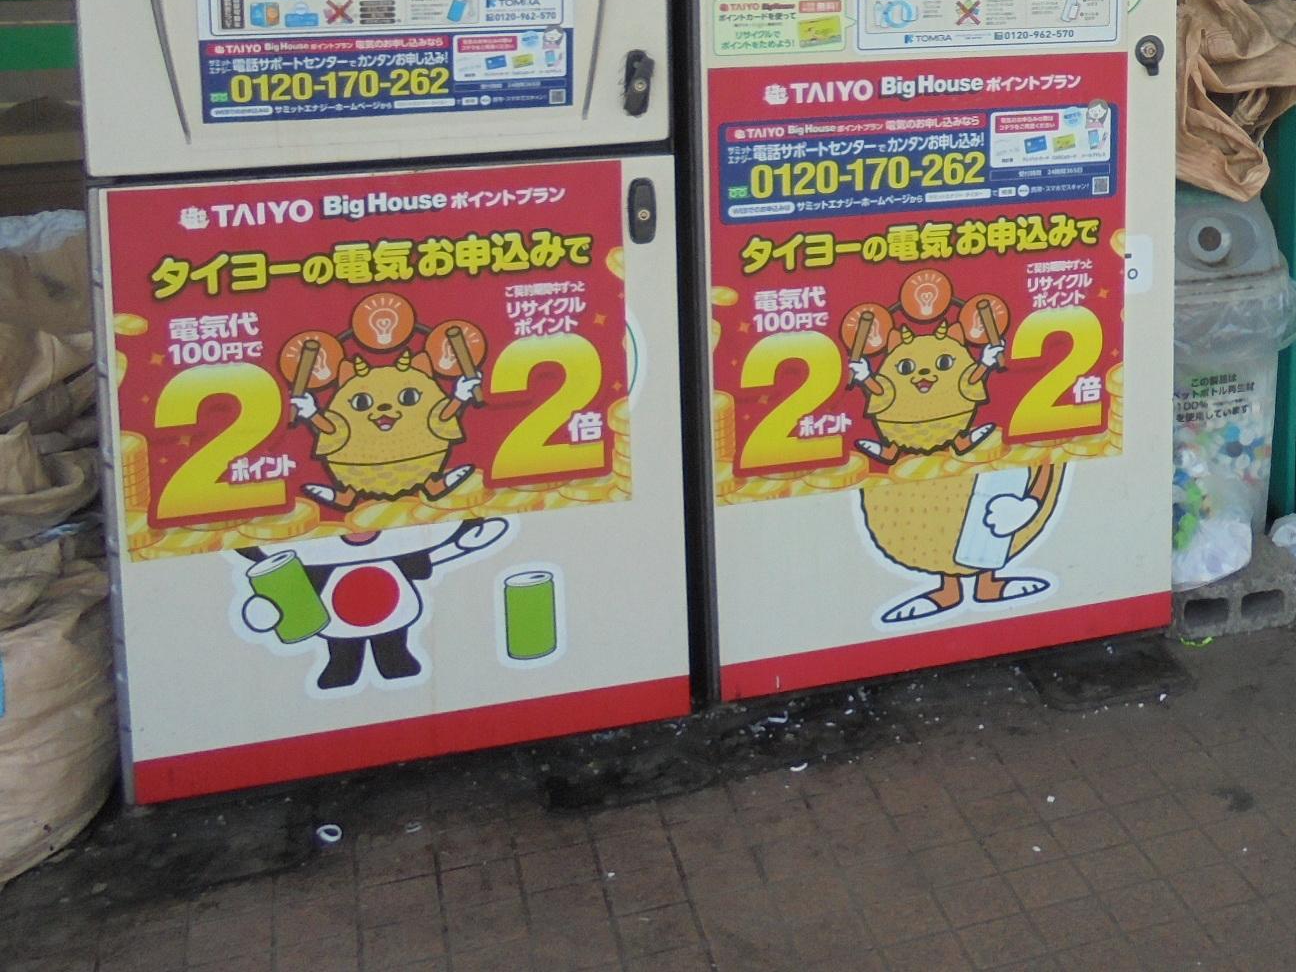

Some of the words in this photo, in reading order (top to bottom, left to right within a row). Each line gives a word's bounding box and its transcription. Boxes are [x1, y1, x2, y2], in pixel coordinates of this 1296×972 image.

[1004, 30, 1074, 40] 0120-962-570
[226, 44, 262, 54] TAIYO
[231, 67, 449, 102] 0120-170-262
[790, 80, 873, 103] TAIYO
[987, 74, 1081, 93] ポイントプラン
[748, 128, 784, 139] TAIYO
[750, 151, 985, 198] 0120-170-262
[211, 198, 313, 227] TAIYO
[1027, 274, 1093, 291] リサイクル
[506, 297, 586, 317] リサイクル
[754, 286, 826, 310] 電気代
[1032, 289, 1086, 307] ポイント
[169, 312, 259, 342] 電気代
[514, 315, 579, 335] ポイント
[753, 309, 828, 332] 100円で
[168, 340, 263, 365] 100円で
[1009, 307, 1102, 437] 2
[740, 332, 843, 469] 2
[1072, 378, 1102, 404] 倍
[490, 334, 605, 480] 2
[567, 412, 603, 442] 倍
[799, 415, 852, 437] ポイント
[154, 363, 287, 519] 2
[230, 456, 297, 482] ポイント
